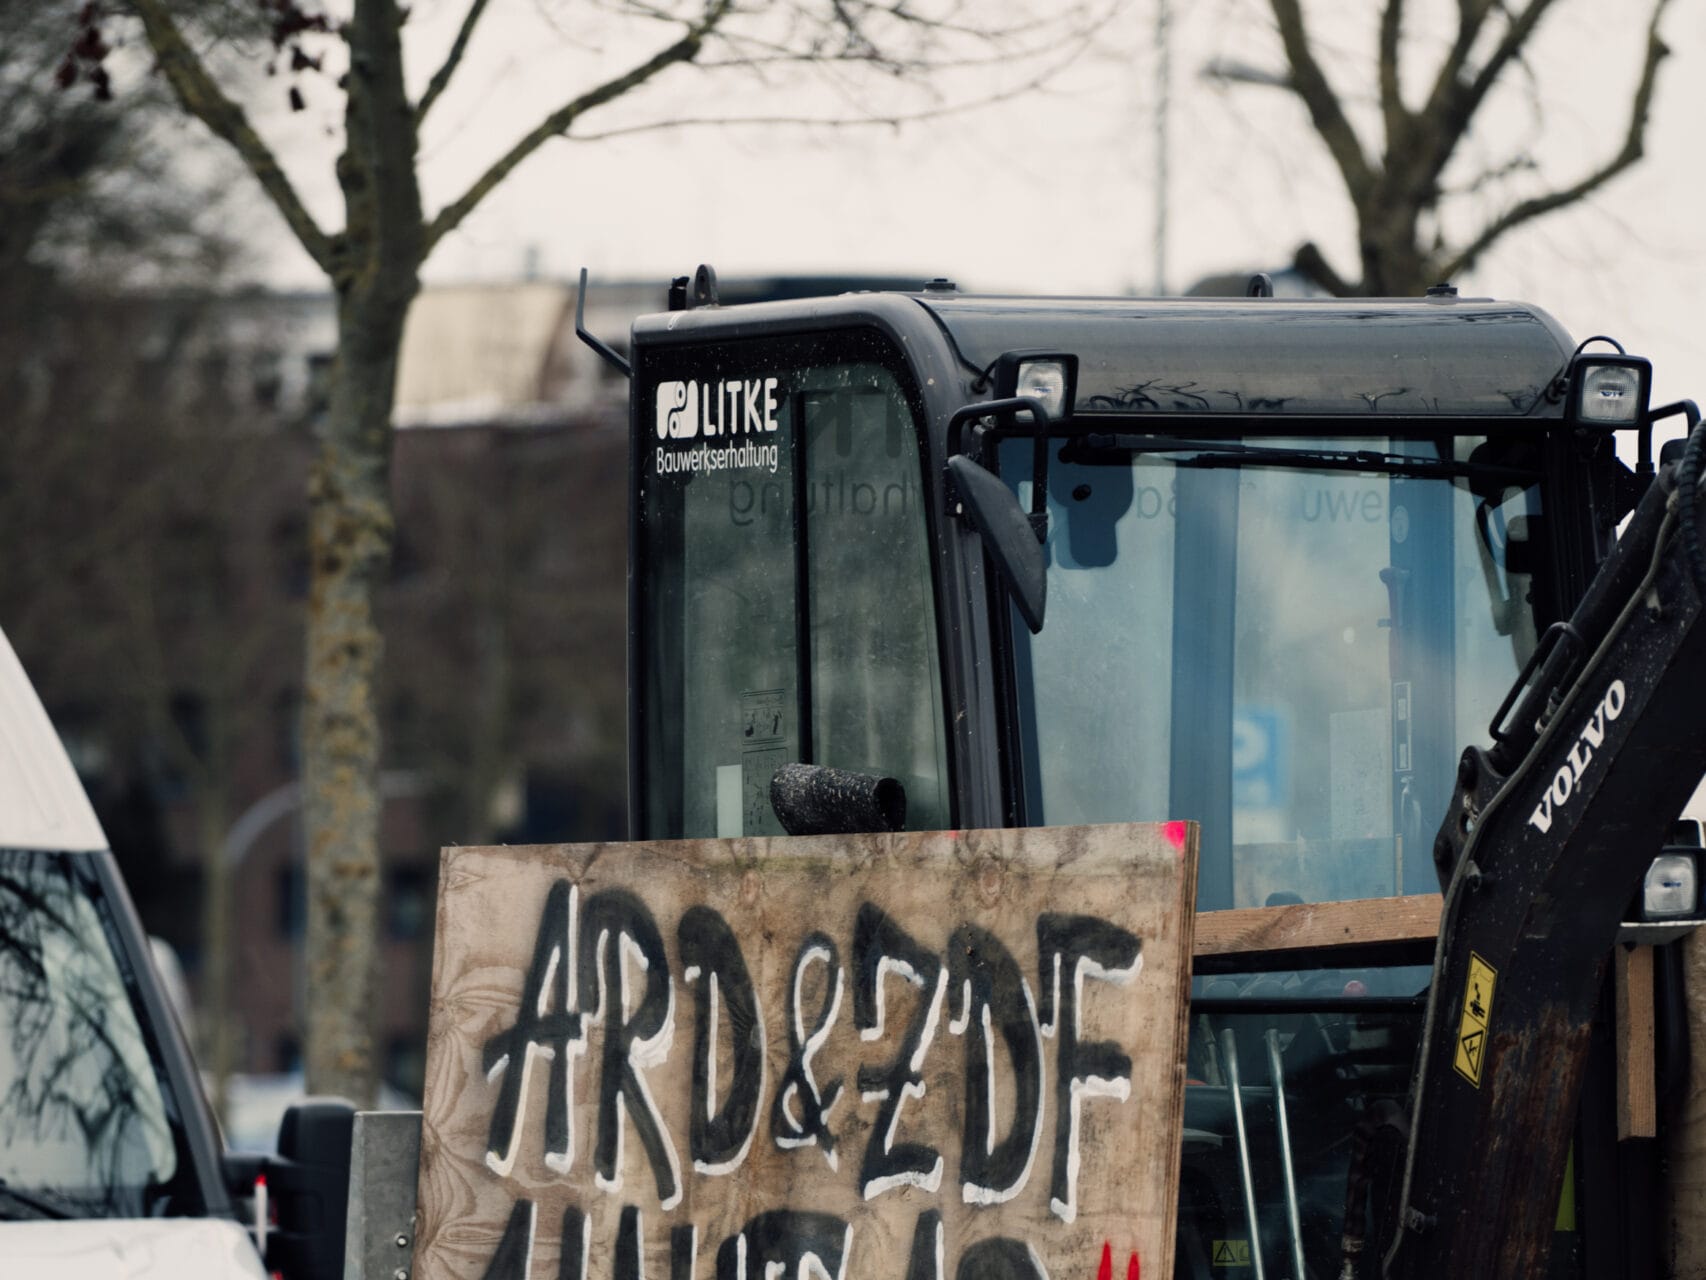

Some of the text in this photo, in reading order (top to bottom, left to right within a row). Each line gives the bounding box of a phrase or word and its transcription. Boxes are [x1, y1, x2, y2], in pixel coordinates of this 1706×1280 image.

[702, 377, 778, 436] LITKE
[656, 439, 778, 474] Bauwerkserhaltung
[1527, 679, 1626, 835] VOLVO
